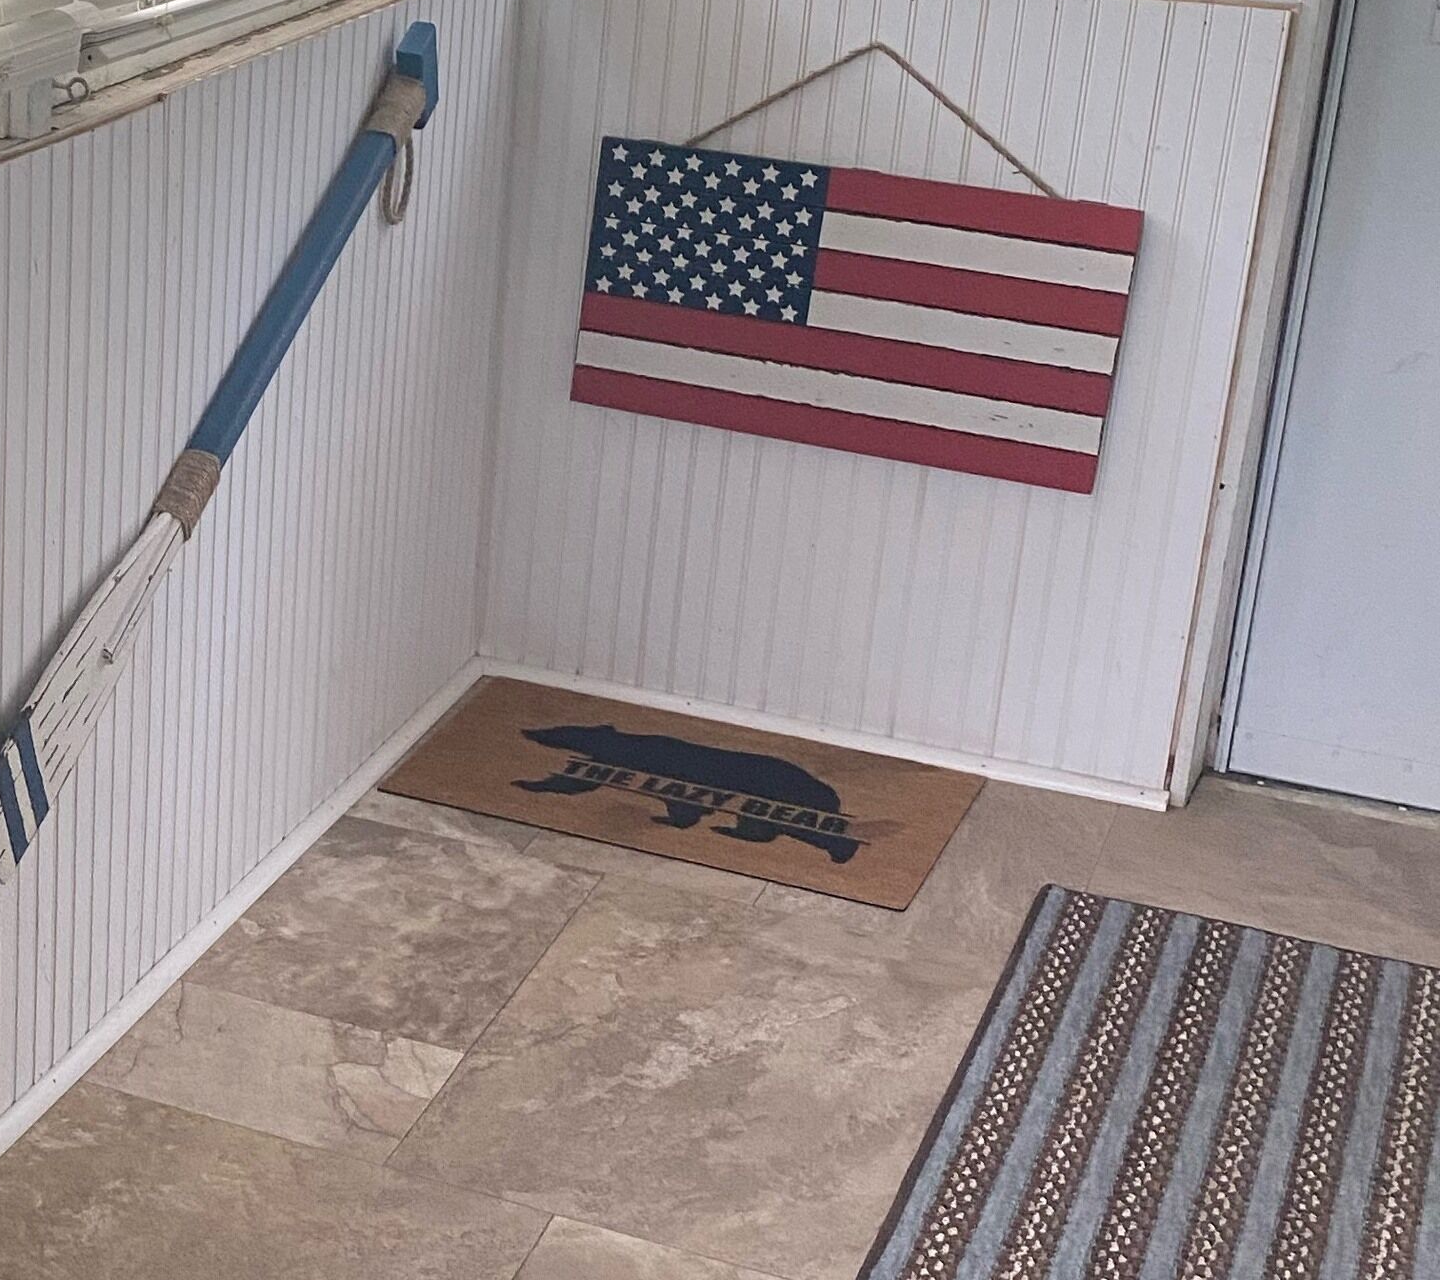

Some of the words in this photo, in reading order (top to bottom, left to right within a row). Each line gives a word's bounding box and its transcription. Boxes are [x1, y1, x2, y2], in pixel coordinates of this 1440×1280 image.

[563, 758, 638, 788] THE
[641, 776, 736, 808] LAZY
[739, 796, 851, 836] BEAR
